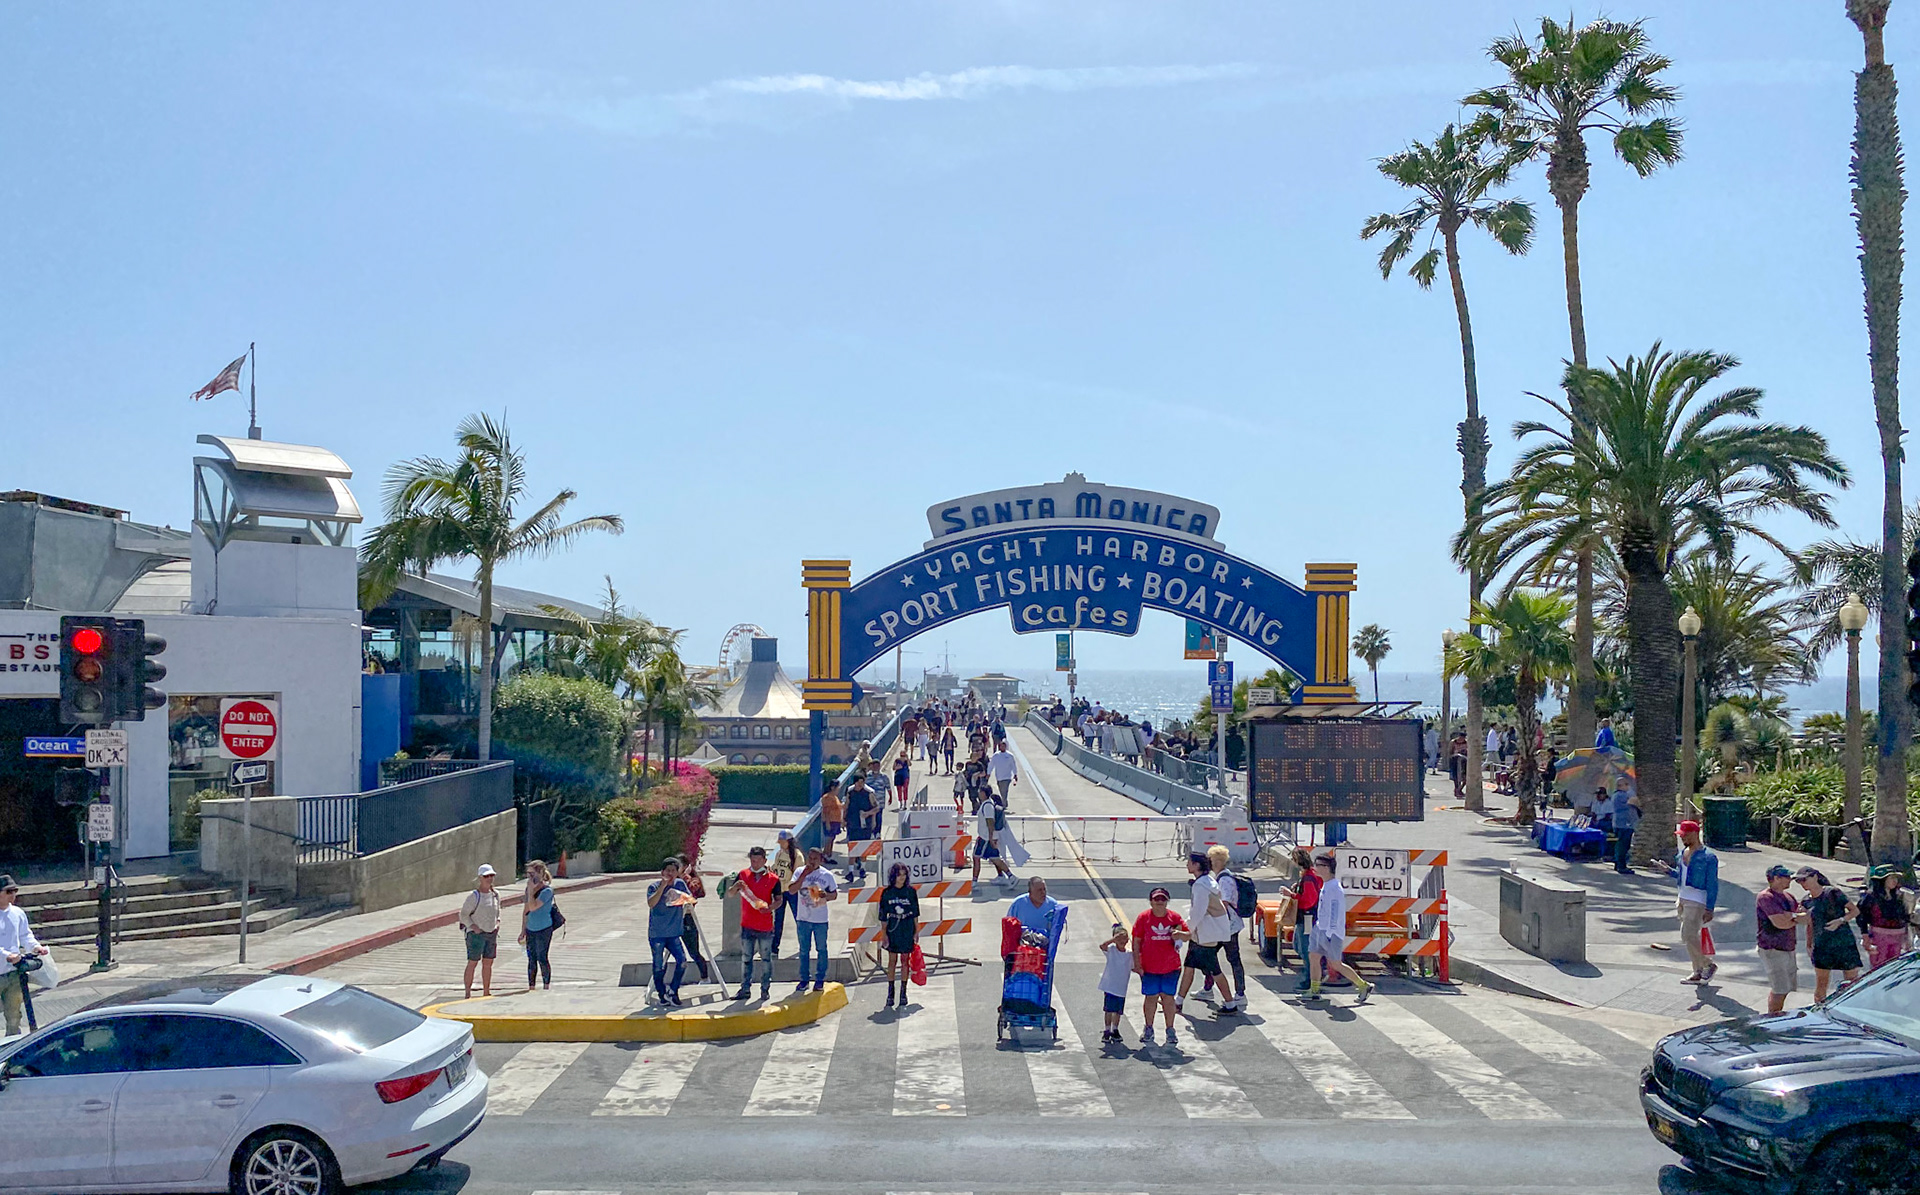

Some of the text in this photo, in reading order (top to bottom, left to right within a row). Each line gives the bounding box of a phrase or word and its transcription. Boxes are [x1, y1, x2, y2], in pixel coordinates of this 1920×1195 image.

[941, 491, 1208, 537] SANTA MONICA
[924, 536, 1229, 584] YACHT HARBOR
[864, 564, 1283, 648] SPORT FISHING BOATING
[1022, 596, 1128, 629] cafes
[26, 633, 58, 641] THE
[229, 711, 270, 722] DO NOT
[28, 739, 69, 751] Ocean
[232, 737, 265, 748] ENTER
[88, 749, 103, 763] OK
[243, 766, 264, 777] ONE WAY
[1257, 758, 1414, 783] SECTION
[893, 845, 931, 860] ROAD
[1348, 855, 1395, 870] ROAD
[908, 863, 938, 878] SED
[1341, 877, 1403, 891] CLOSED
